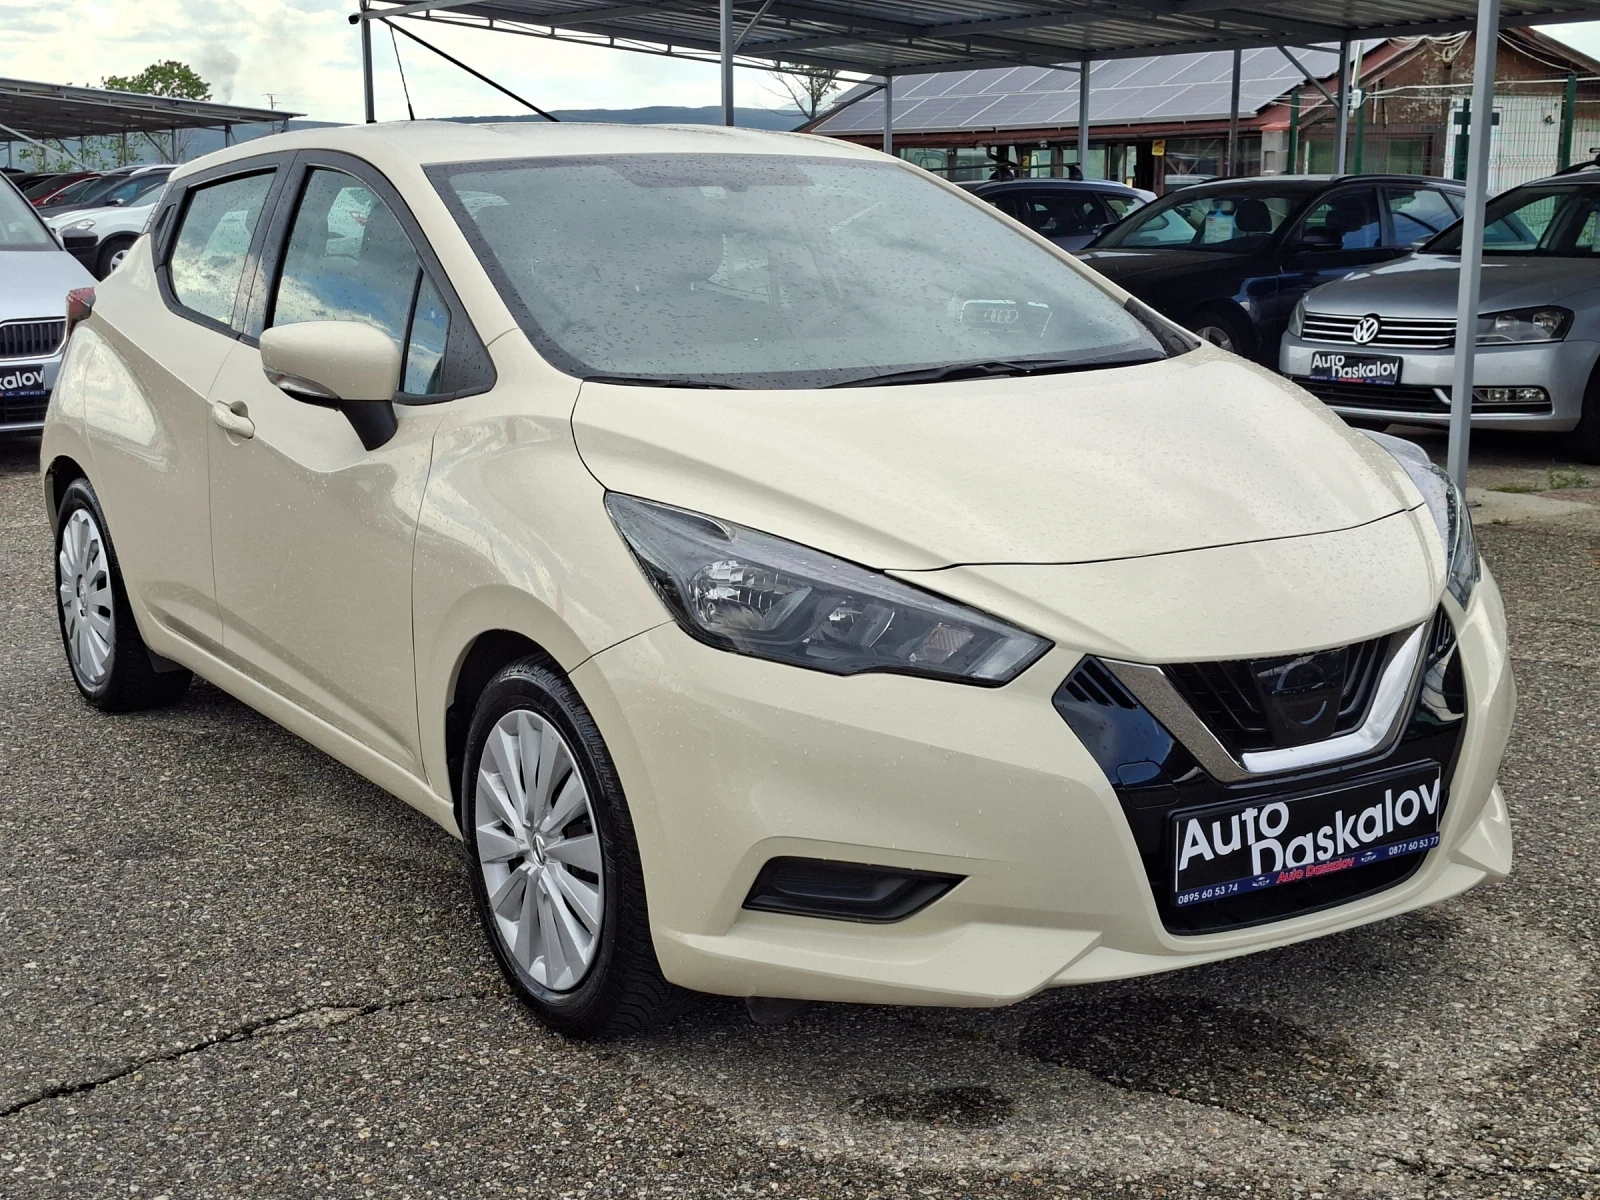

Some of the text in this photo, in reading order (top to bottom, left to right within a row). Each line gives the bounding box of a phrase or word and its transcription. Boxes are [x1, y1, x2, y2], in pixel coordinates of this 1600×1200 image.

[1312, 353, 1345, 369] Auto
[1332, 361, 1398, 379] Daskalov
[1179, 802, 1289, 871] Auto
[1252, 779, 1439, 875] Daskalov
[1389, 836, 1439, 855] 0877 60 53 77
[1276, 857, 1355, 883] Auto Daskalov
[1178, 883, 1238, 904] 0895 60 53 74
